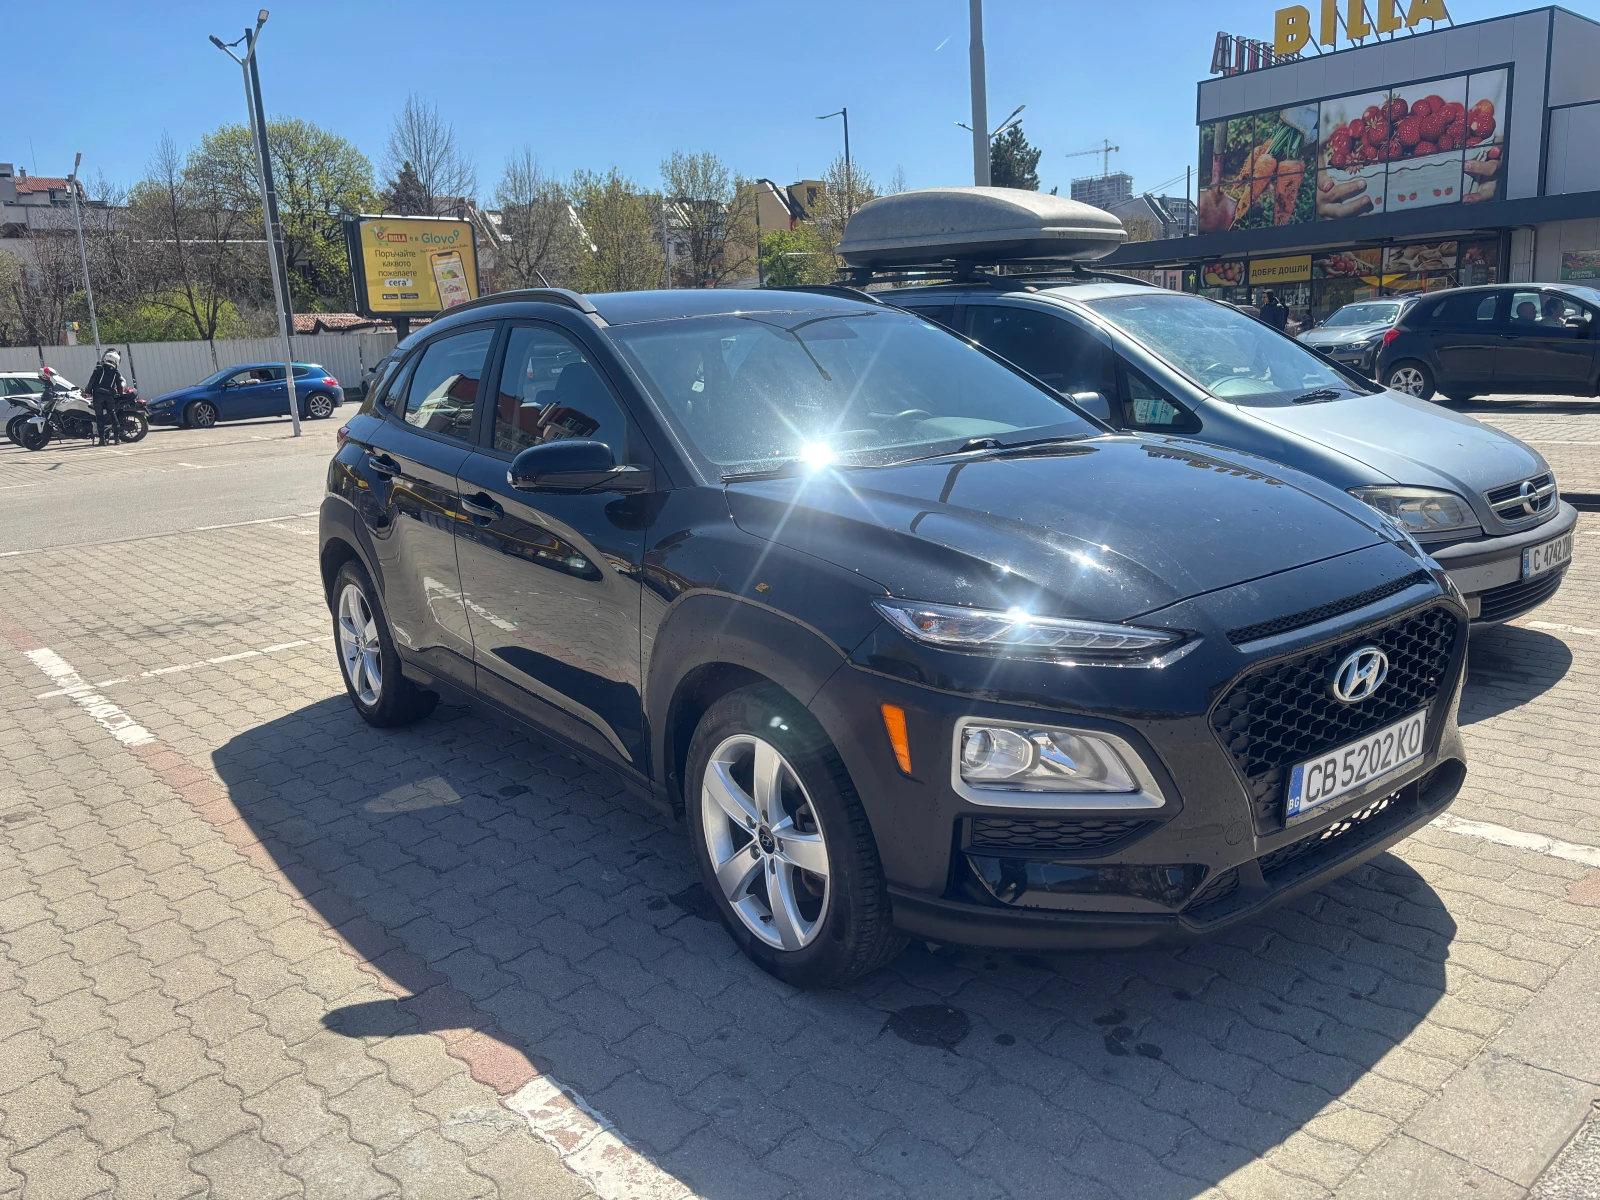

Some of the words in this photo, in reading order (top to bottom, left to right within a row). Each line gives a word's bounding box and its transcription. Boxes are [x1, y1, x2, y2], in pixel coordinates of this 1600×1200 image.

[1274, 0, 1447, 56] BILLA
[421, 231, 457, 245] Glovo
[374, 249, 416, 259] Поръчайте
[382, 260, 411, 268] каквото
[1251, 267, 1277, 278] ДОБРЕ
[1278, 264, 1308, 275] ДОШЛИ
[1534, 549, 1540, 571] C
[1544, 541, 1562, 566] 4742
[1288, 796, 1300, 811] BG
